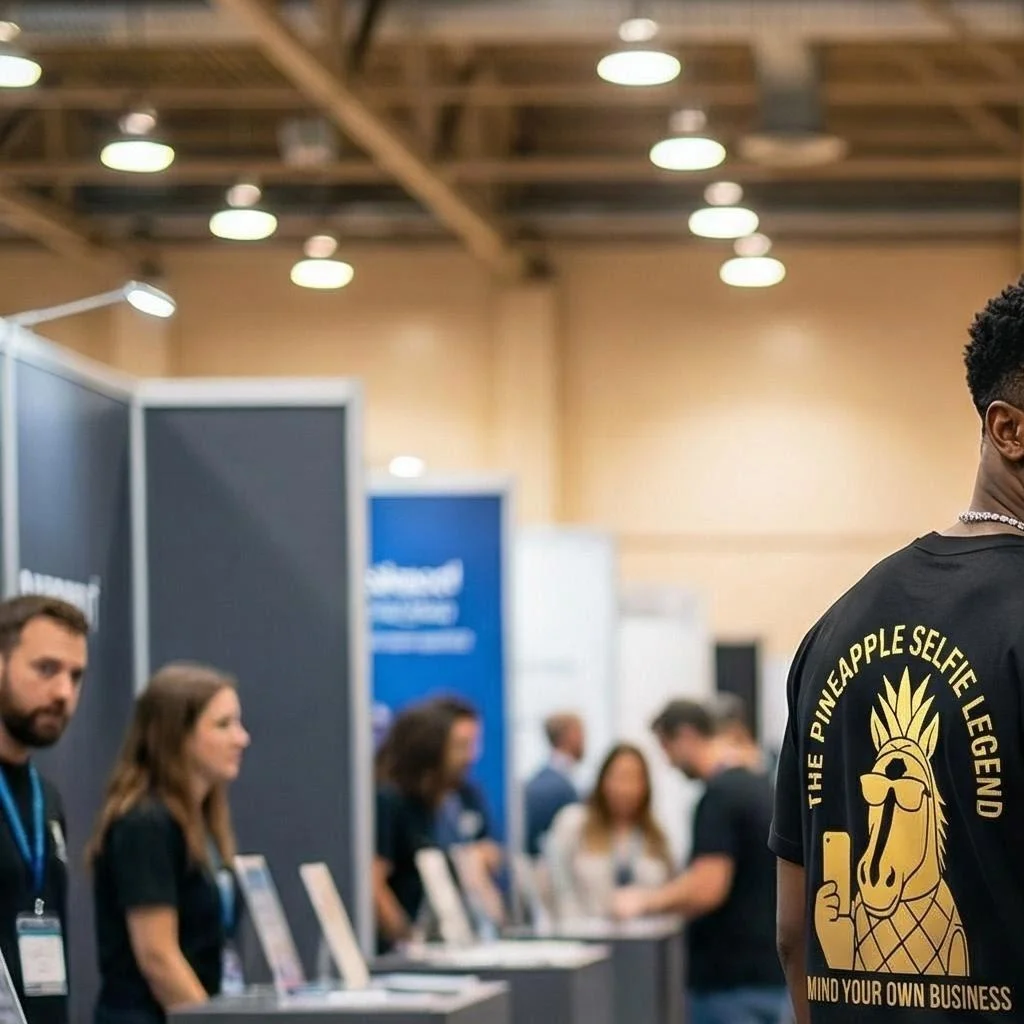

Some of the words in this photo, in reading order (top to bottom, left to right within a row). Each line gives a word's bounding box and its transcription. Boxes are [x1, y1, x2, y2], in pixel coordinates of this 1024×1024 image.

[810, 625, 905, 742] PINEAPPLE
[909, 625, 977, 698] SELFIE
[808, 754, 823, 809] THE
[962, 696, 1003, 818] LEGEND
[807, 976, 839, 1001] MIND
[841, 979, 882, 1005] YOUR
[886, 981, 924, 1008] OWN
[930, 983, 1012, 1011] BUSINESS
